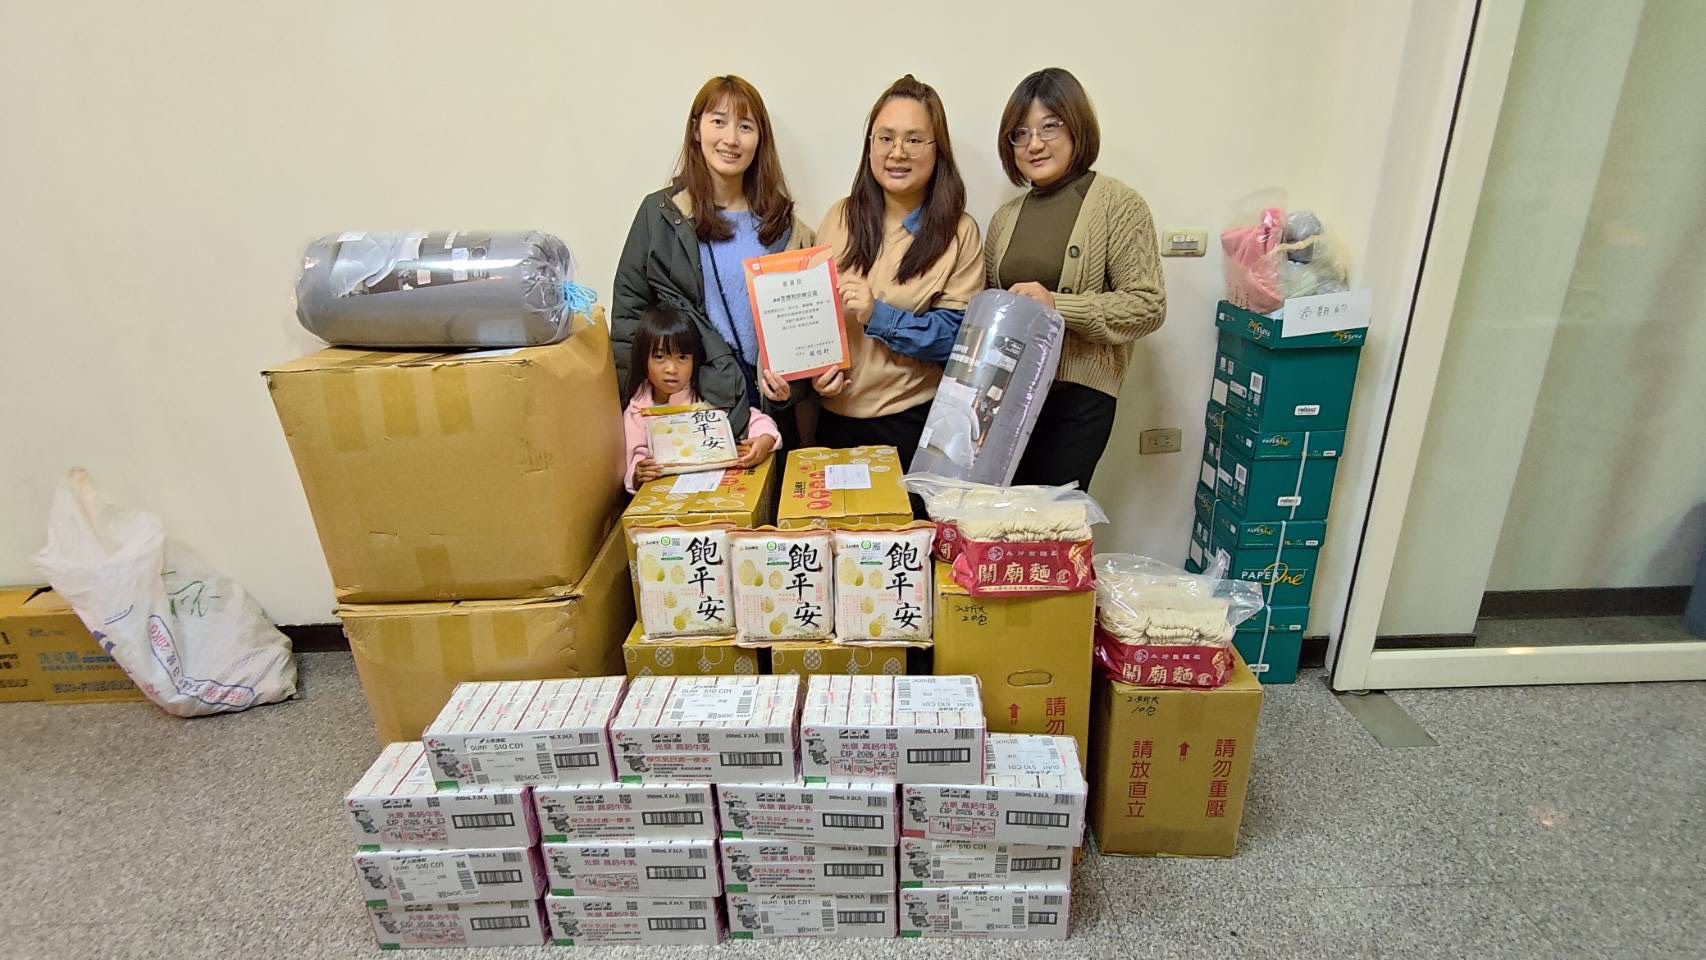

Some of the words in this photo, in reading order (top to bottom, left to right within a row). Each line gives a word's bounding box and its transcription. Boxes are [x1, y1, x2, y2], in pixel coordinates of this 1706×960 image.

[691, 411, 725, 450] 飽平安
[685, 536, 726, 622] 飽平安
[786, 543, 823, 628] 飽平安
[885, 541, 923, 629] 飽平安
[978, 562, 1051, 584] 關廟麵
[1122, 663, 1193, 685] 關廟麵
[1125, 740, 1153, 818] 請放直立
[1205, 738, 1236, 818] 請勿重壓
